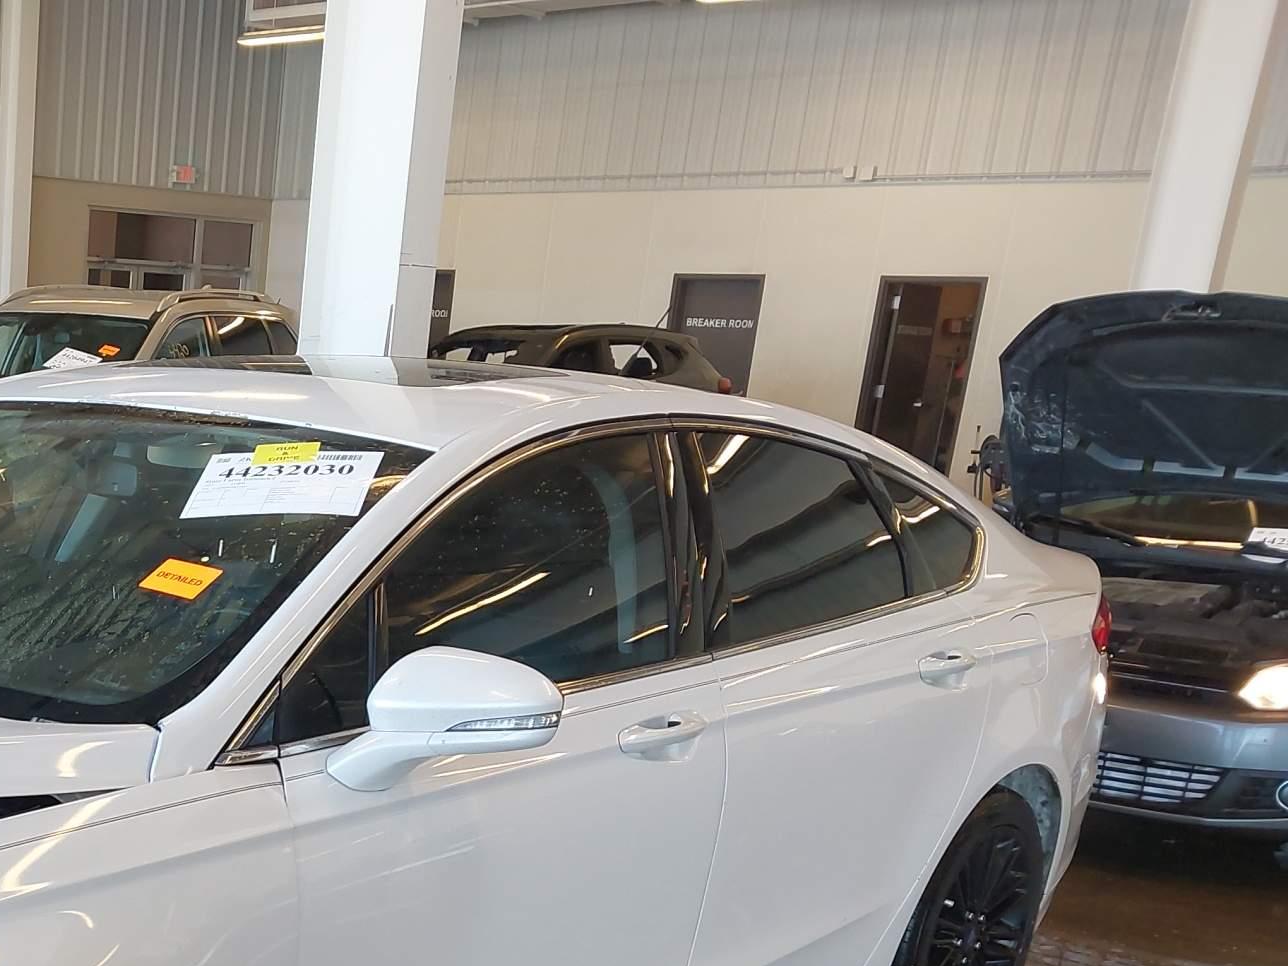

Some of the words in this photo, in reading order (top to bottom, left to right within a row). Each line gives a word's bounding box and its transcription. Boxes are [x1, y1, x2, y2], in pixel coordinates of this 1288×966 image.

[686, 317, 727, 328] BREAKER
[219, 464, 355, 478] 44232030
[156, 570, 204, 587] DETAILED
